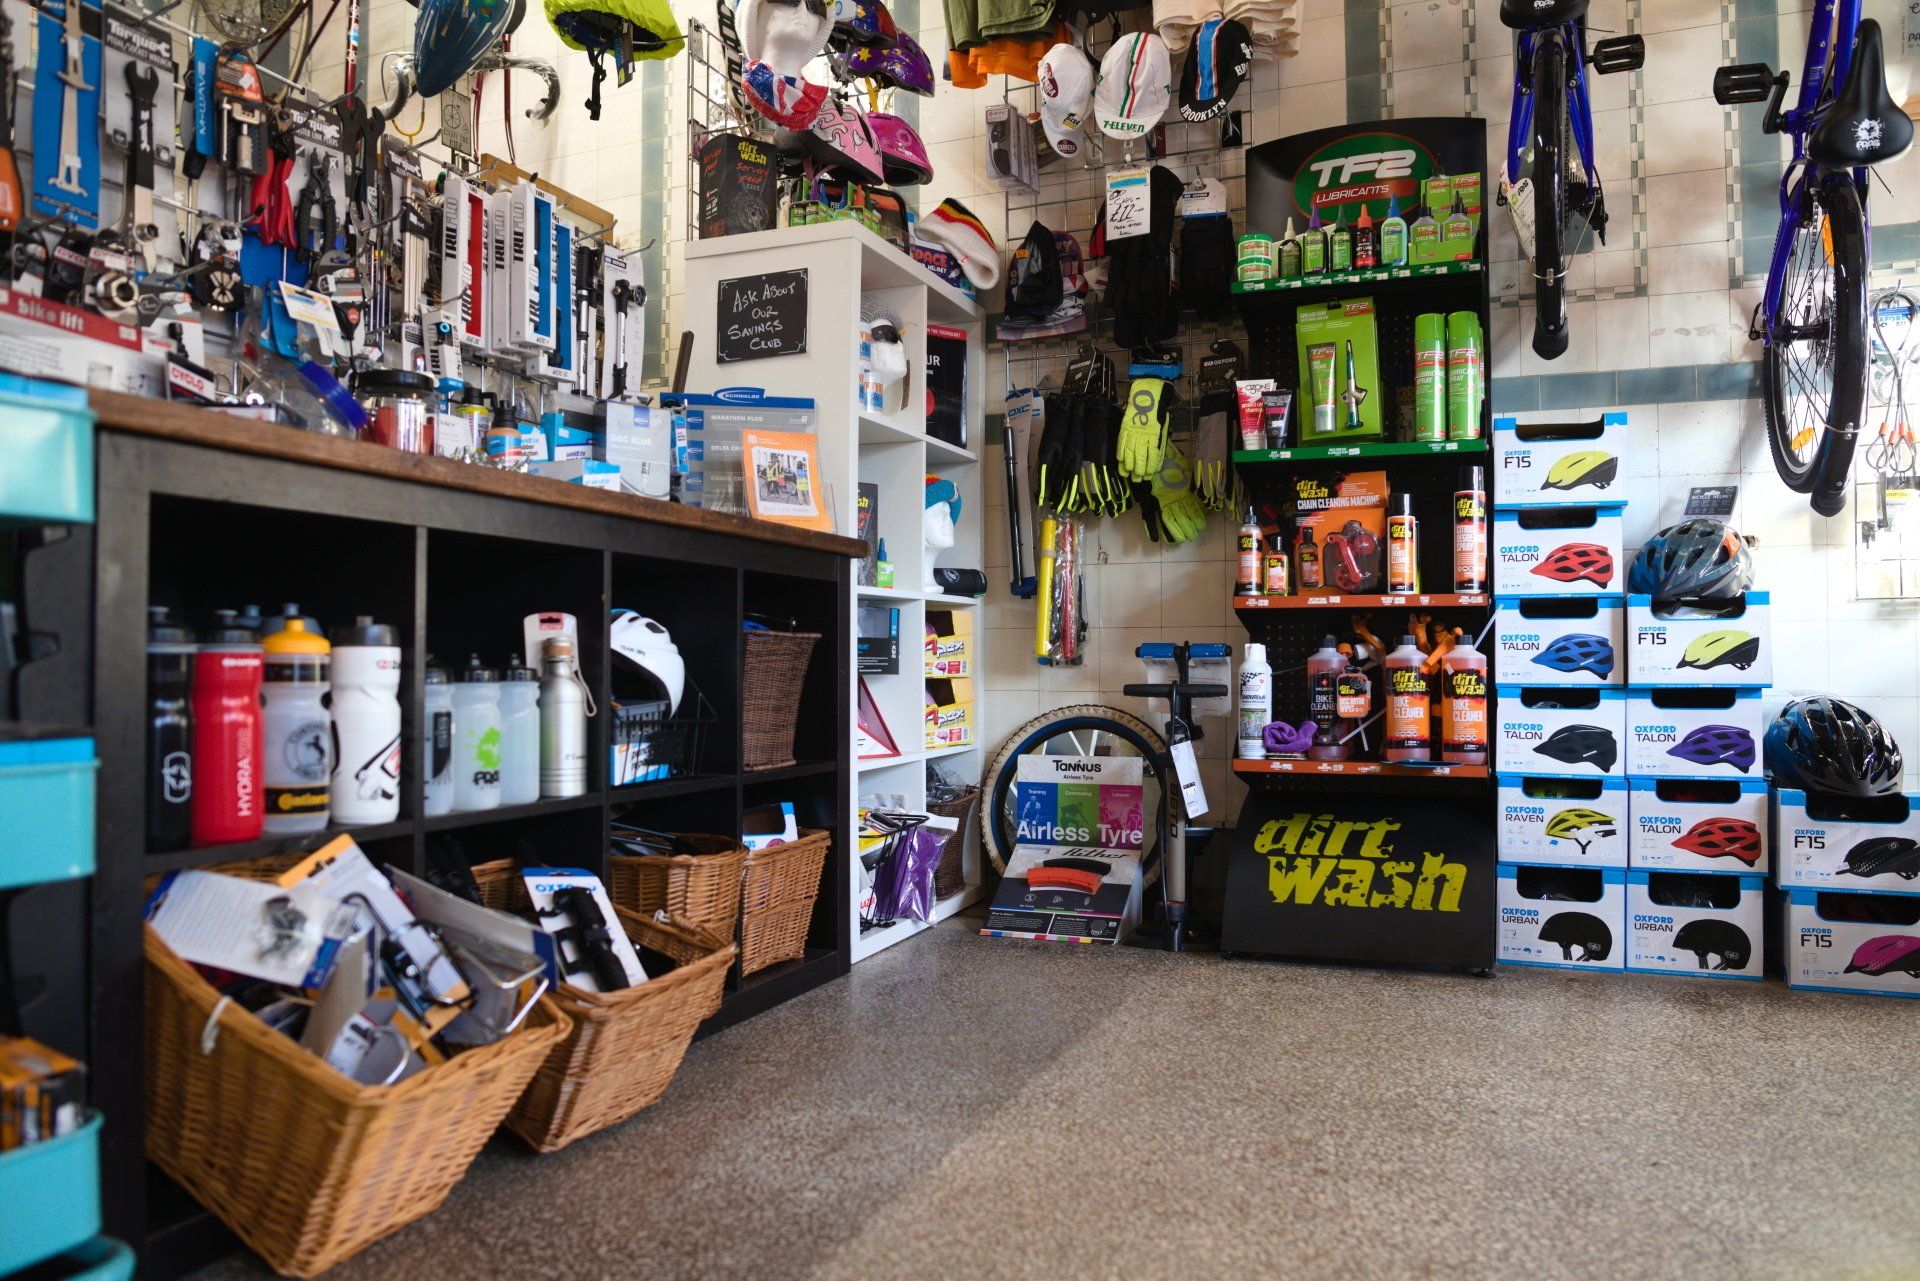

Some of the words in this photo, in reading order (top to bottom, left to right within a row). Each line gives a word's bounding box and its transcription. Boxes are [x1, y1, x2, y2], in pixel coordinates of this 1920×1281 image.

[1180, 98, 1227, 122] BROOKLYN
[1103, 119, 1145, 133] 7-ELEVEN
[738, 141, 758, 154] dirt
[741, 151, 767, 166] wash
[1310, 149, 1416, 188] TF2
[1316, 184, 1390, 203] LUBRICANTS
[762, 282, 796, 300] ABOUT
[751, 306, 778, 319] OUR
[60, 311, 84, 332] lift
[727, 319, 783, 340] SAVINGS
[749, 337, 782, 350] CLUB
[170, 366, 206, 393] CYCLO
[1007, 404, 1031, 417] OXC
[711, 414, 746, 422] MARATHON
[1504, 456, 1531, 469] F15
[1296, 479, 1318, 492] dirt
[1299, 485, 1329, 499] wash
[1297, 499, 1317, 510] CHAIN
[1318, 497, 1350, 509] CLEANING
[1350, 494, 1381, 507] MACHINE
[1457, 498, 1477, 510] dirt
[1458, 507, 1485, 518] wash
[1500, 545, 1539, 554] OXFORD
[1500, 553, 1539, 563] TALON
[1501, 634, 1540, 642] OXFORD
[1638, 632, 1667, 645] F15
[1501, 642, 1540, 651] TALON
[1393, 670, 1417, 682] dirt
[1452, 673, 1478, 686] dirt
[1396, 680, 1427, 692] wash
[1455, 685, 1486, 695] wash
[1315, 694, 1334, 703] BIKE
[1393, 696, 1410, 707] BIKE
[1453, 699, 1470, 710] BIKE
[1311, 702, 1336, 711] CLEANE
[1393, 707, 1424, 718] CLEANER
[1453, 710, 1483, 722] CLEANER
[1504, 723, 1543, 731] OXFORD
[1634, 725, 1677, 733] OXFORD
[1504, 731, 1543, 740] TALON
[1635, 733, 1676, 743] TALON
[1053, 759, 1102, 773] Tannus
[1028, 788, 1047, 796] Training
[1505, 806, 1544, 815] OXFORD
[1505, 814, 1544, 823] RAVEN
[1639, 816, 1682, 825] OXFORD
[1016, 820, 1090, 842] Airless
[1096, 823, 1143, 848] Tyre
[1253, 812, 1402, 858] dirt
[1639, 824, 1682, 834] TALON
[1794, 836, 1825, 849] F15
[1267, 851, 1468, 912] wash
[1501, 907, 1539, 917] OXFORD
[1501, 916, 1539, 925] URBAN
[1633, 914, 1674, 924] OXFORD
[1634, 923, 1673, 933] URBAN
[1801, 935, 1832, 948] F15
